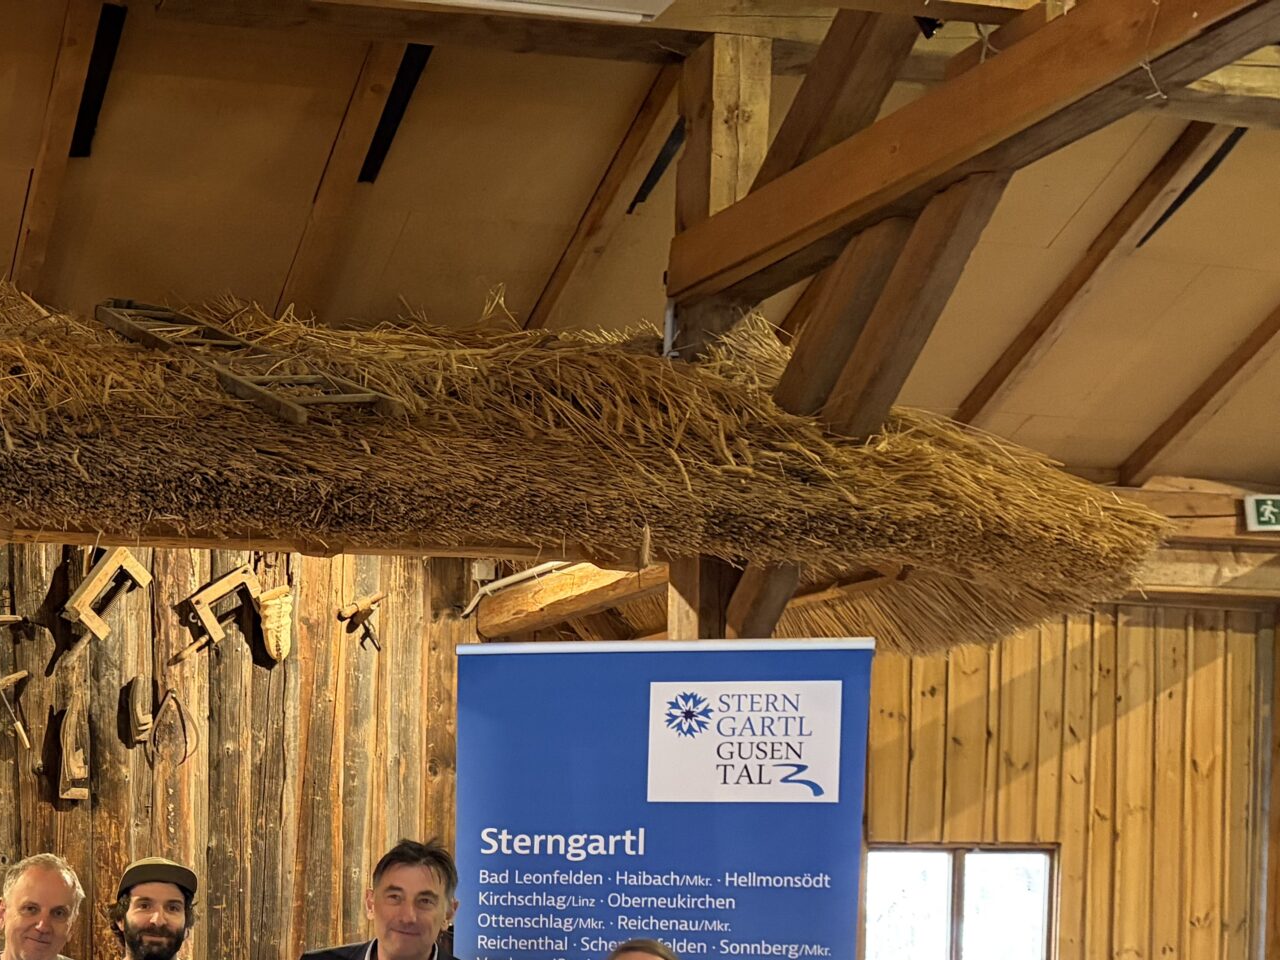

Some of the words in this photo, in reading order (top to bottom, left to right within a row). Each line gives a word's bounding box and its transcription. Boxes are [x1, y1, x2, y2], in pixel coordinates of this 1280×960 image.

[718, 693, 800, 713] STERN
[716, 716, 813, 737] GARTL
[716, 741, 804, 760] GUSEN
[716, 763, 772, 785] TAL
[480, 827, 645, 862] Sterngartl
[479, 869, 509, 885] Bad
[515, 870, 603, 885] Leonfelden
[616, 870, 712, 887] Haibach/Mkr.
[725, 871, 832, 889] Hellmonsödt
[478, 891, 596, 910] Kirchschlag/Linz
[607, 892, 736, 909] Oberneukirchen
[477, 913, 606, 932] Ottenschlag/Mkr.
[617, 915, 732, 932] Reichenau/Mkr.
[477, 935, 568, 951] Reichenthal
[720, 939, 832, 959] Sonnberg/Mkr.
